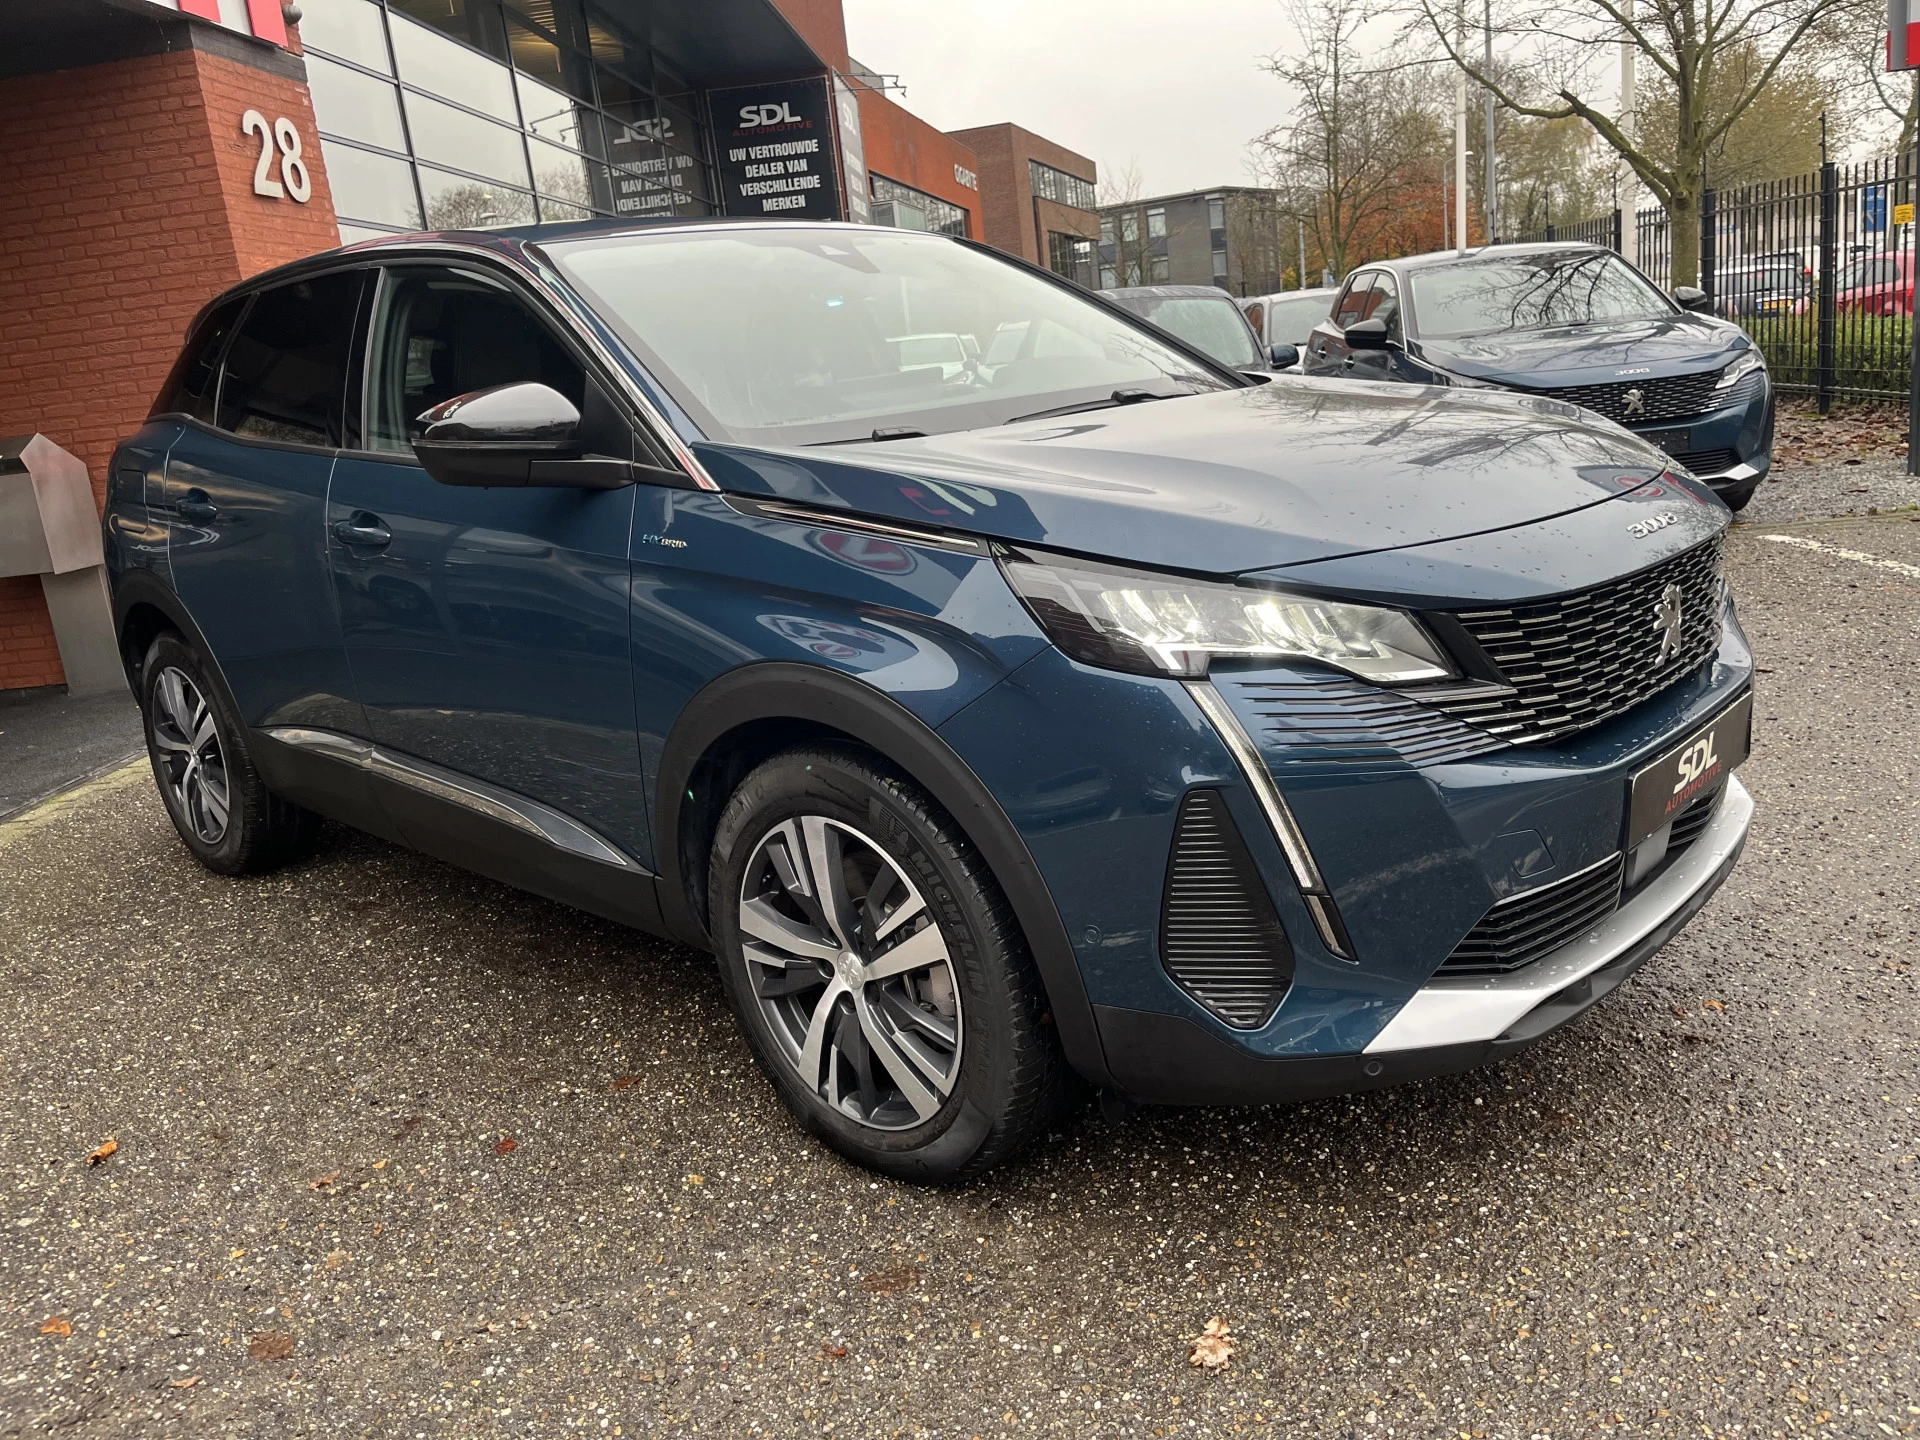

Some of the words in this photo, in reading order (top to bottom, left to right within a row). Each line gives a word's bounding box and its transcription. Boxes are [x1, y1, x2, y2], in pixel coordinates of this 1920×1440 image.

[739, 102, 801, 128] SDL
[732, 120, 813, 137] AUTOMOTIVE
[242, 109, 311, 203] 28
[729, 147, 747, 162] UW
[748, 139, 819, 160] VERTROUWDE
[745, 161, 785, 178] DEALER
[785, 158, 808, 174] VAN
[739, 175, 821, 197] VERSCHILLENDE
[762, 194, 806, 212] MERKEN
[1626, 512, 1678, 539] 3008
[1673, 731, 1718, 795] SDL
[1665, 760, 1722, 815] AUTOMOTIVE
[911, 850, 986, 995] MICHELIN
